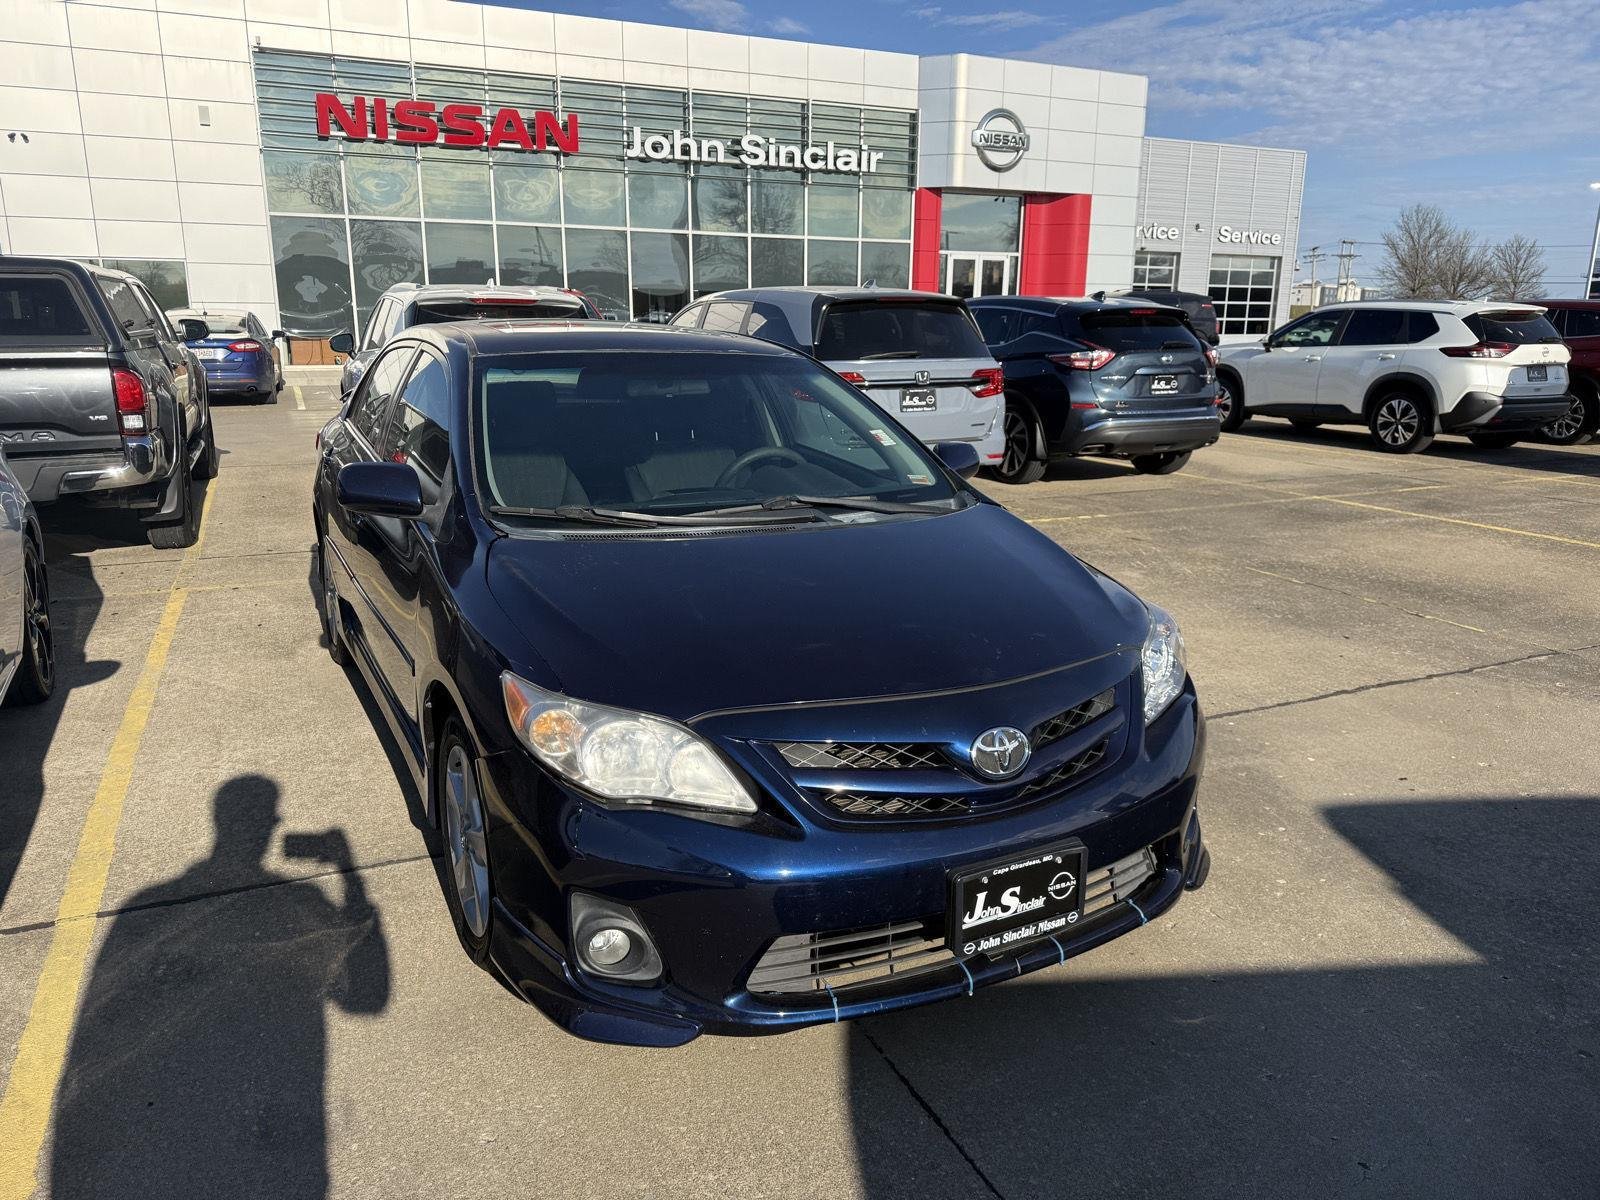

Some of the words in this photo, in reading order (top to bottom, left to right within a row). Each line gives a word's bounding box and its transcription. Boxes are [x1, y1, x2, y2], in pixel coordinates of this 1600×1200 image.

[315, 93, 579, 153] NISSAN
[626, 127, 725, 163] John
[739, 134, 884, 172] Sinclair
[979, 133, 1026, 147] NISSAN
[1218, 225, 1281, 245] Service
[992, 866, 1010, 876] Cape
[1042, 854, 1053, 863] MO
[1048, 879, 1077, 892] NISSAN
[963, 891, 1001, 924] John
[998, 886, 1046, 917] Sinclair
[977, 937, 1001, 952] John
[1002, 925, 1037, 944] Sinclair
[1037, 917, 1066, 933] Nissan
